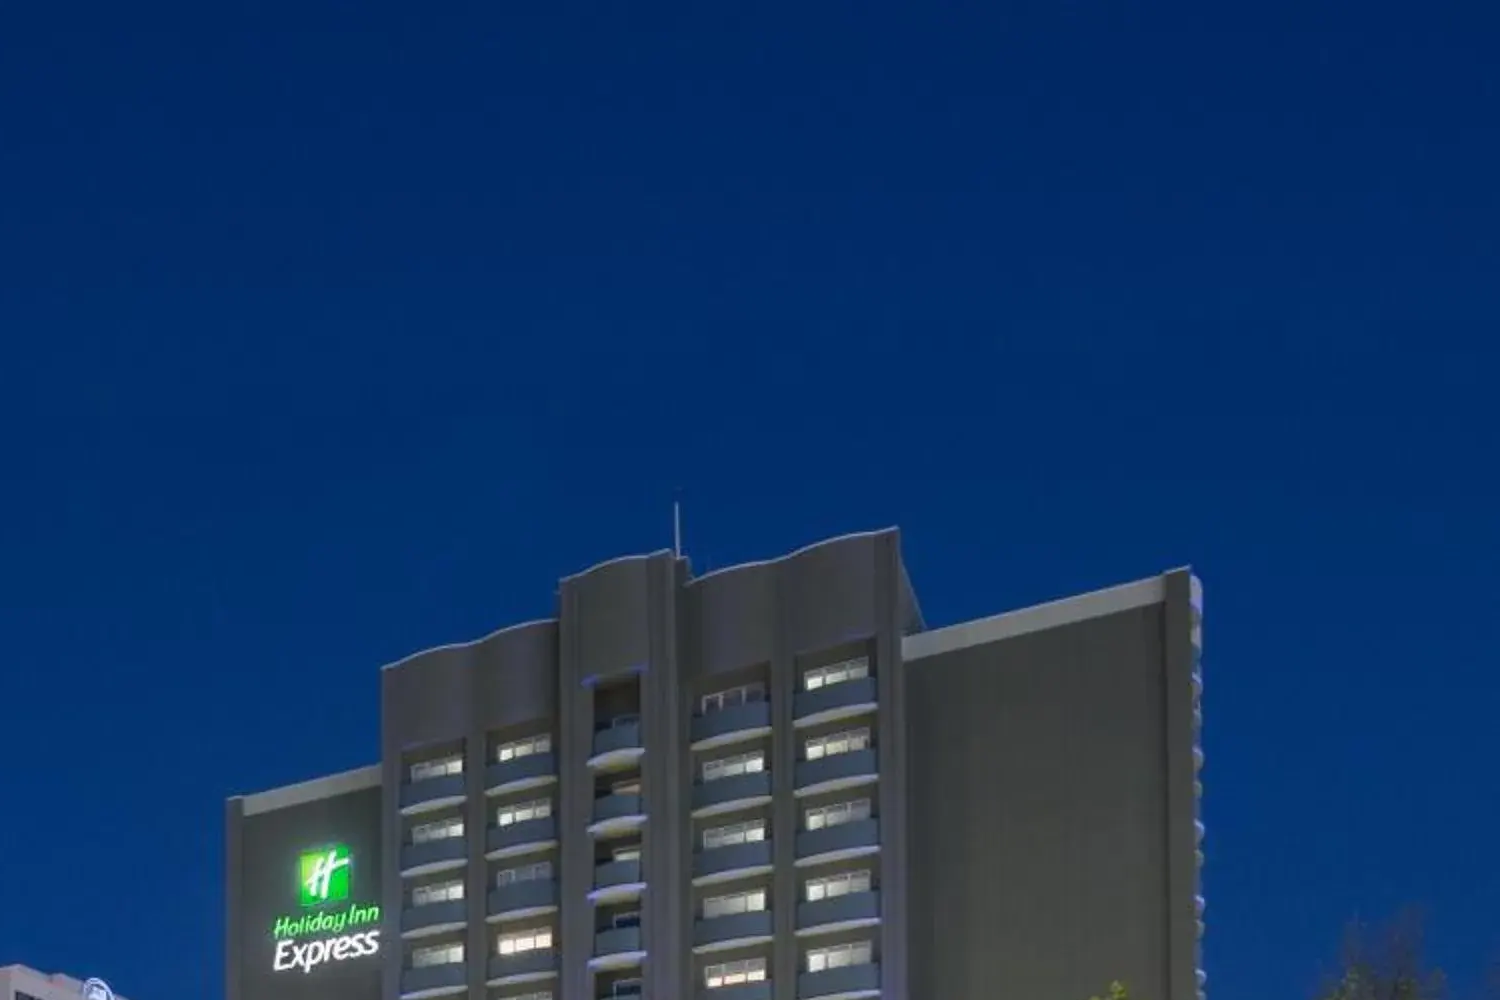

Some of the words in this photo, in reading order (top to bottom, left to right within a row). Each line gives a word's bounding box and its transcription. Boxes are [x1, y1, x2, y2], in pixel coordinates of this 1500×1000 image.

[274, 911, 347, 938] Holiday
[348, 903, 379, 925] Inn
[273, 929, 380, 973] Express
